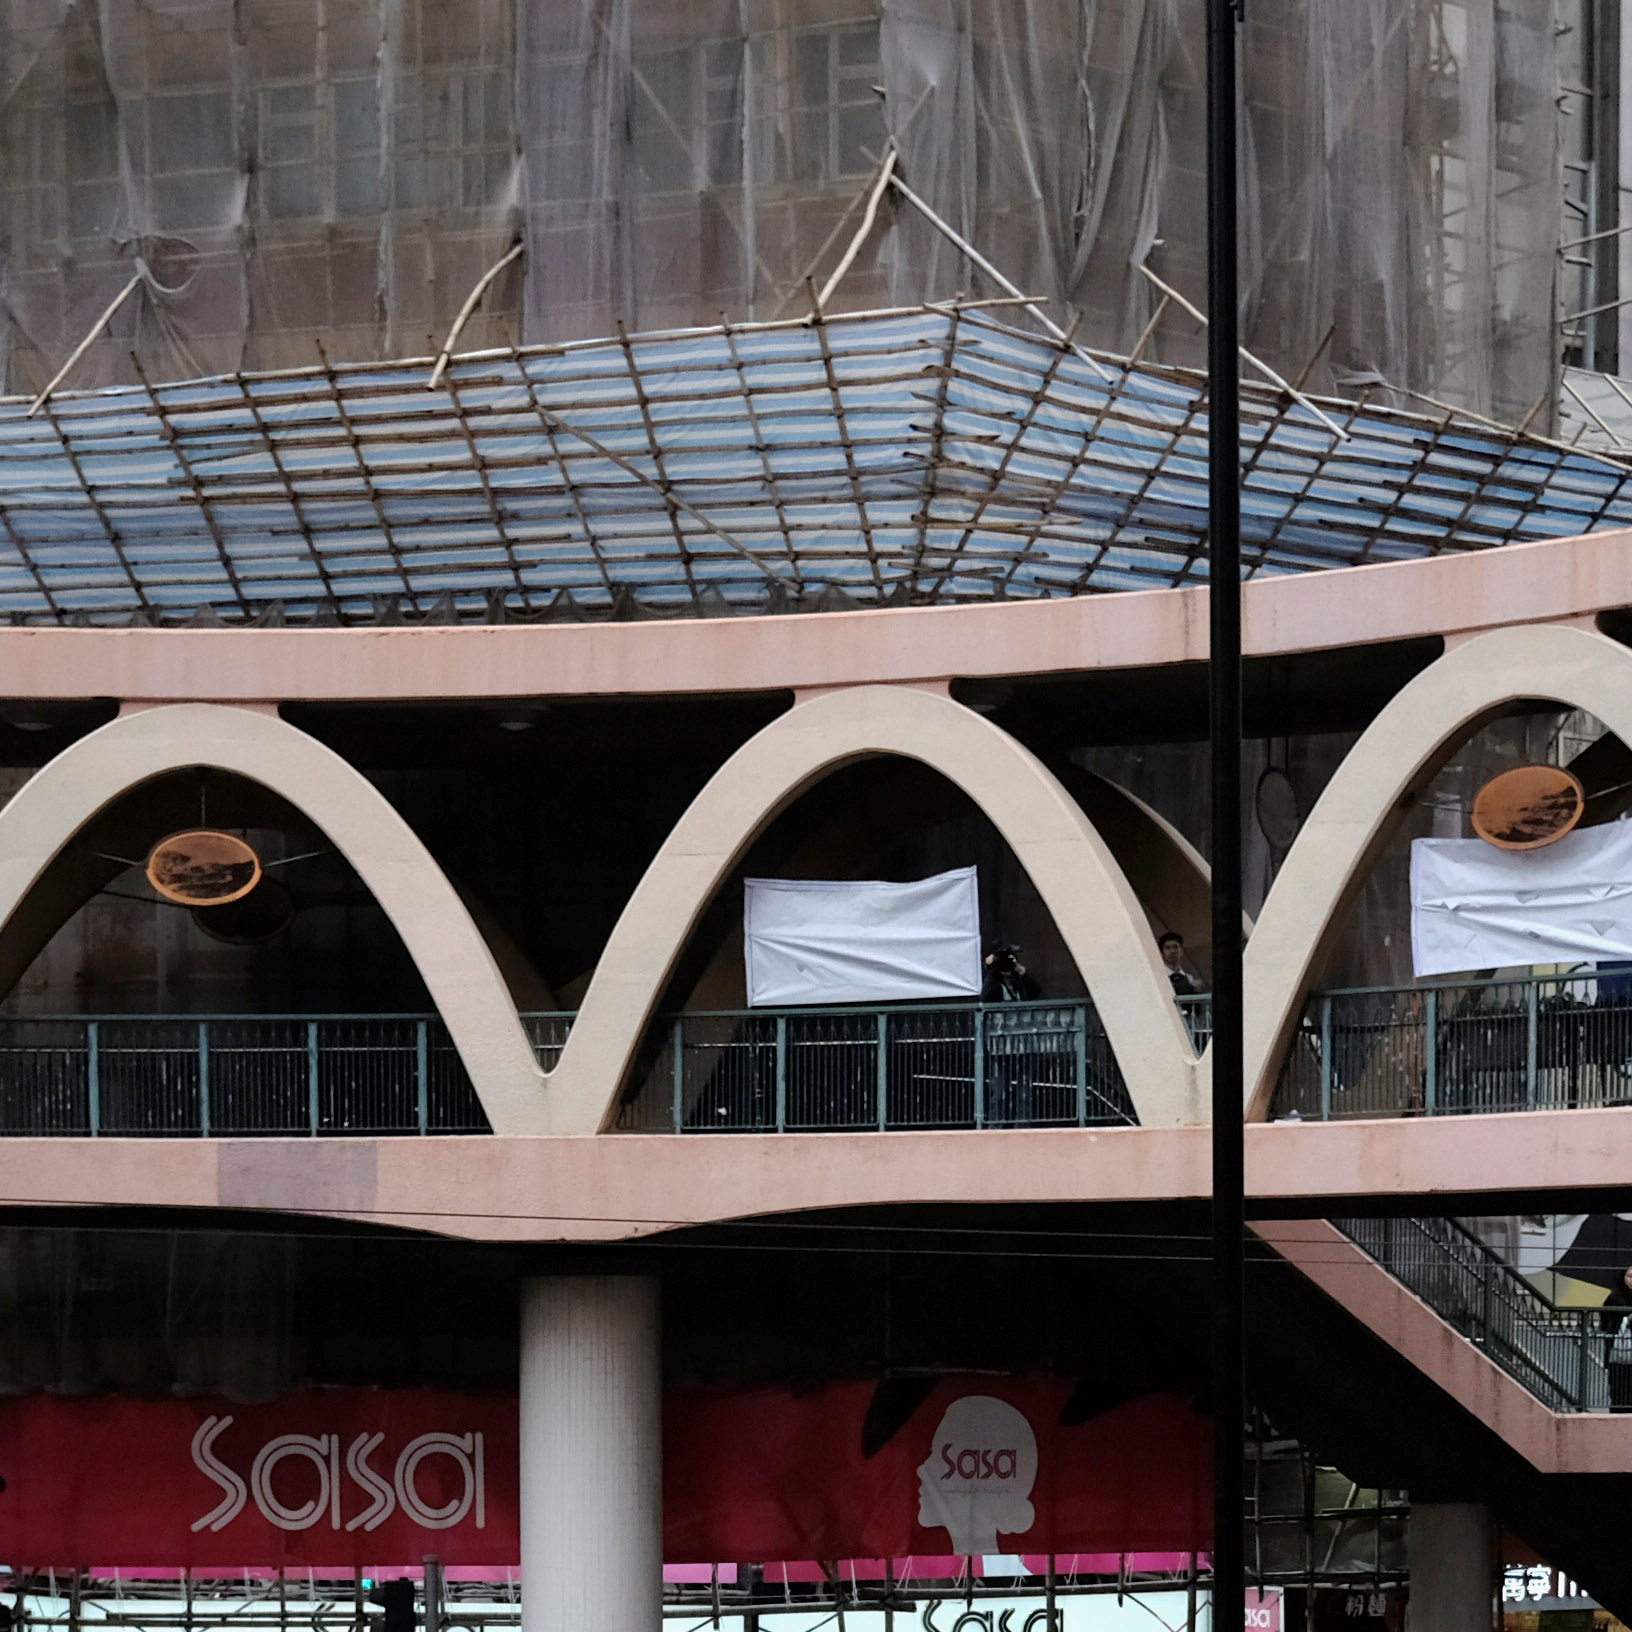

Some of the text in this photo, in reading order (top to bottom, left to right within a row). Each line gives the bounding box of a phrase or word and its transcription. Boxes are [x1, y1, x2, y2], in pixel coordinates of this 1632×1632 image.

[190, 1415, 486, 1533] Sasa
[941, 1443, 1017, 1480] Sasa
[1244, 1607, 1271, 1629] asa
